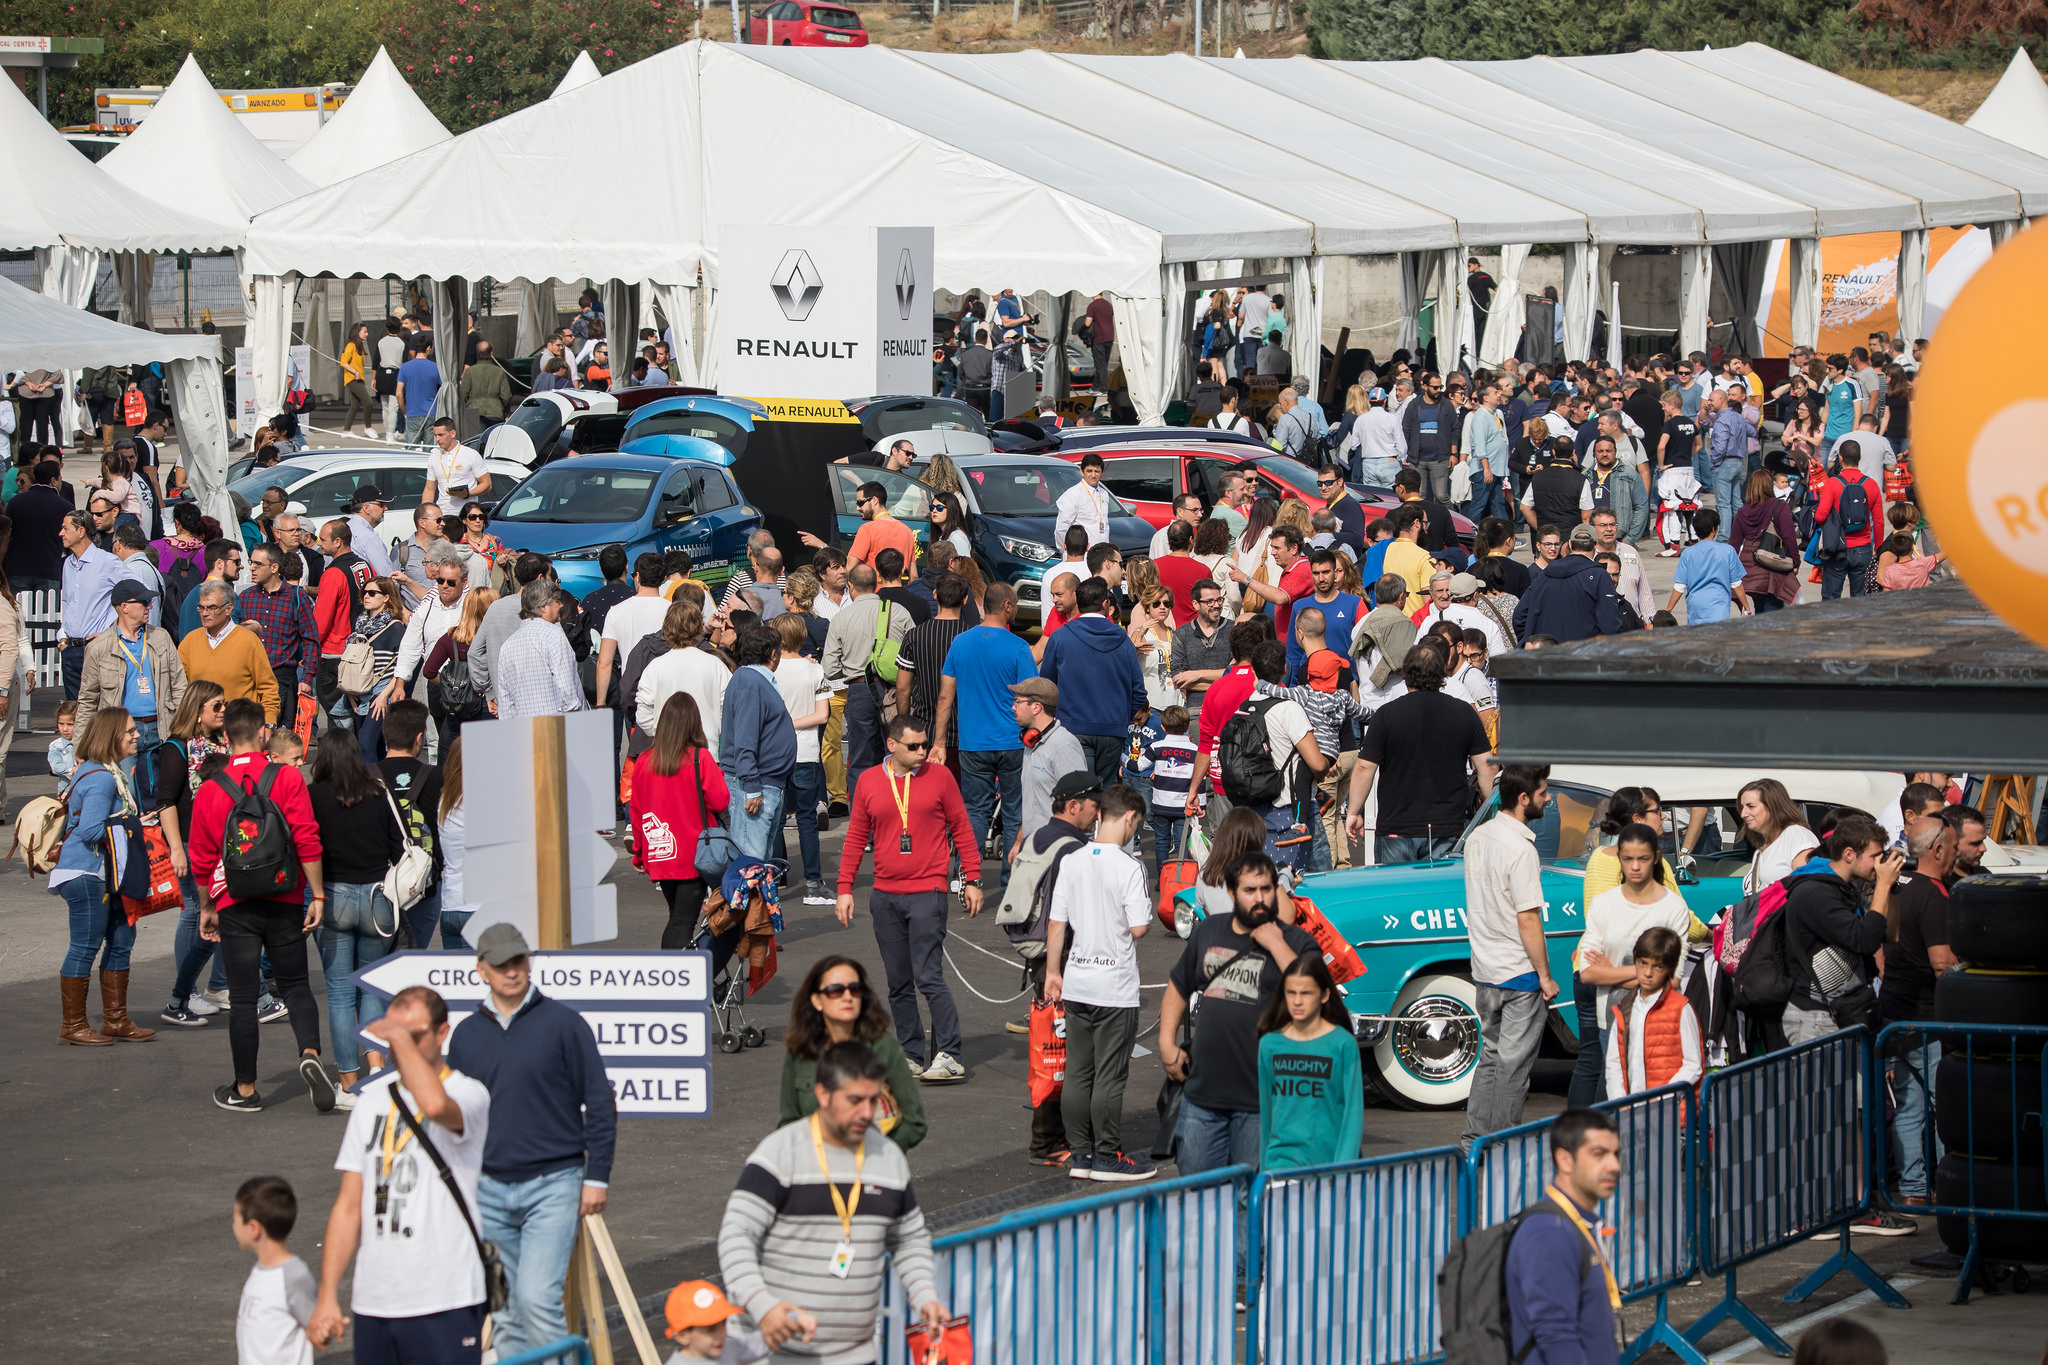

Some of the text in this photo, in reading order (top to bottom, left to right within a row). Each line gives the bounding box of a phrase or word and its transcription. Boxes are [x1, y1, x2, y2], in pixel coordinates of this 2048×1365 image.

[249, 99, 286, 107] AVANZADO
[1822, 273, 1884, 284] RENAULT
[1821, 296, 1879, 306] XPERIENCE
[736, 338, 859, 359] RENAULT
[883, 339, 927, 357] RENAULT
[766, 405, 785, 416] MA
[789, 406, 845, 418] RENAULT
[1161, 748, 1192, 759] GOCCO
[1093, 956, 1116, 966] Auto
[428, 969, 490, 986] CIRC
[540, 969, 582, 986] LOS
[590, 969, 691, 986] PAYASOS
[597, 1022, 689, 1045] LITOS
[1273, 1059, 1328, 1073] NAUGHTY
[1271, 1078, 1324, 1098] NICE
